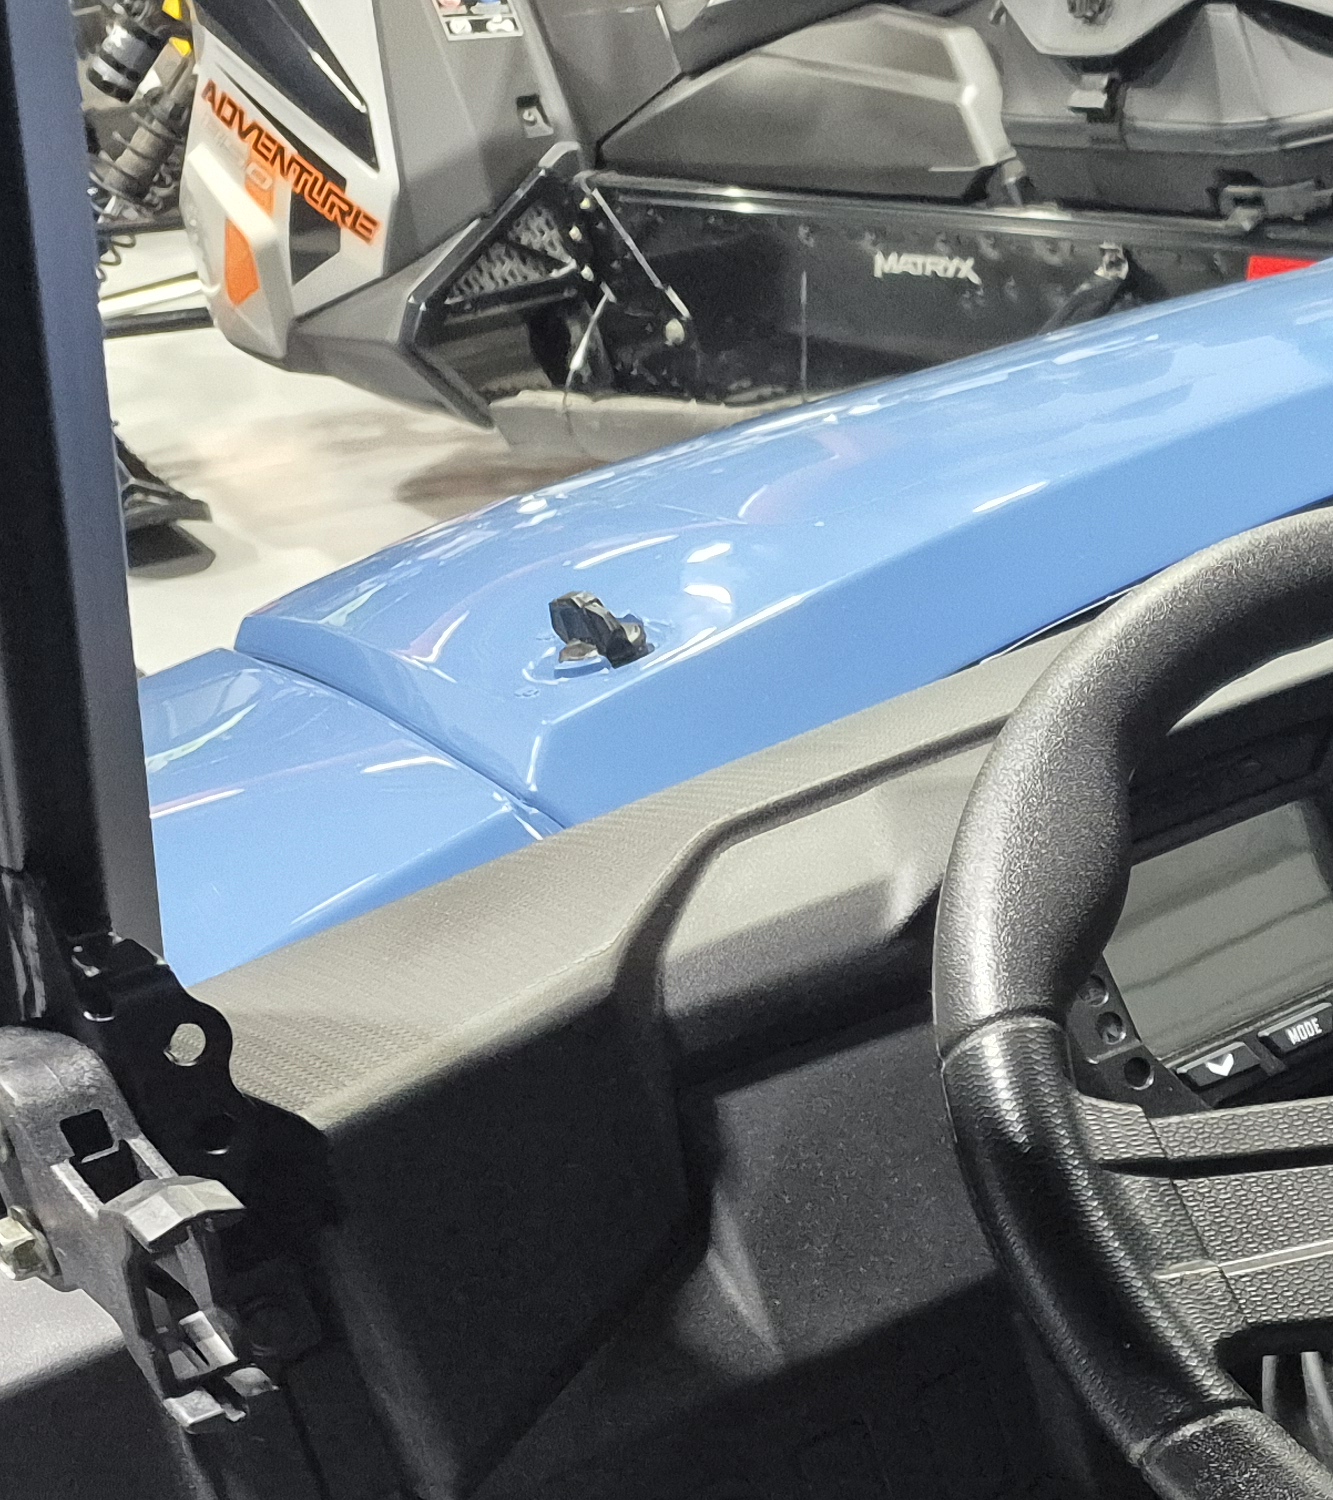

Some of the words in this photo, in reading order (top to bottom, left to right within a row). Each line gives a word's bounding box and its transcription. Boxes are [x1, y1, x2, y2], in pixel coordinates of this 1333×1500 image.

[200, 78, 382, 246] ADVENTURE
[873, 250, 983, 286] MATRYX
[1285, 1016, 1323, 1046] MODE
